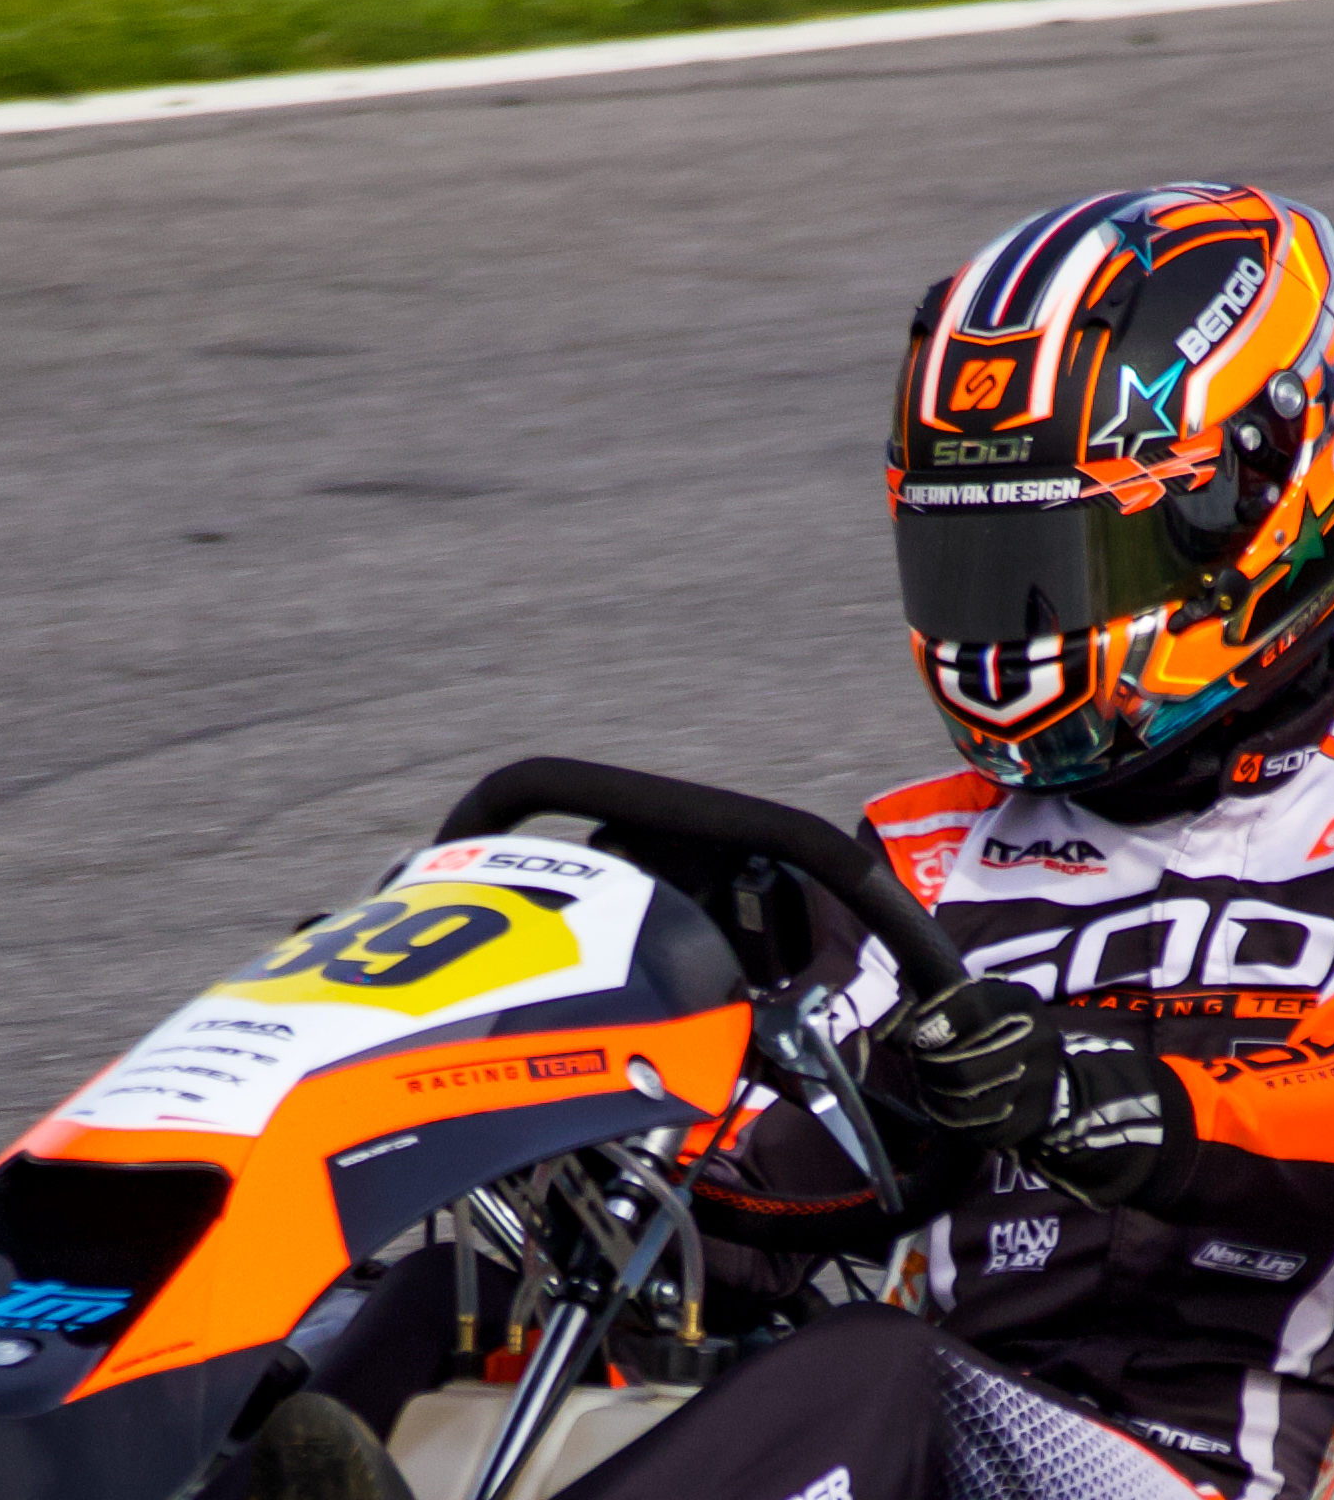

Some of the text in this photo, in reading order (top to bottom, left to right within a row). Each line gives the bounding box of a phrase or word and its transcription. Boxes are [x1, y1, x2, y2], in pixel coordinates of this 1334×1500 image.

[1175, 256, 1266, 365] BENGIO
[992, 477, 1081, 504] DESIGN
[982, 837, 1106, 864] ITAKA
[244, 900, 511, 988] 39
[1069, 995, 1223, 1019] RACING
[406, 1051, 603, 1094] RACING TEAM
